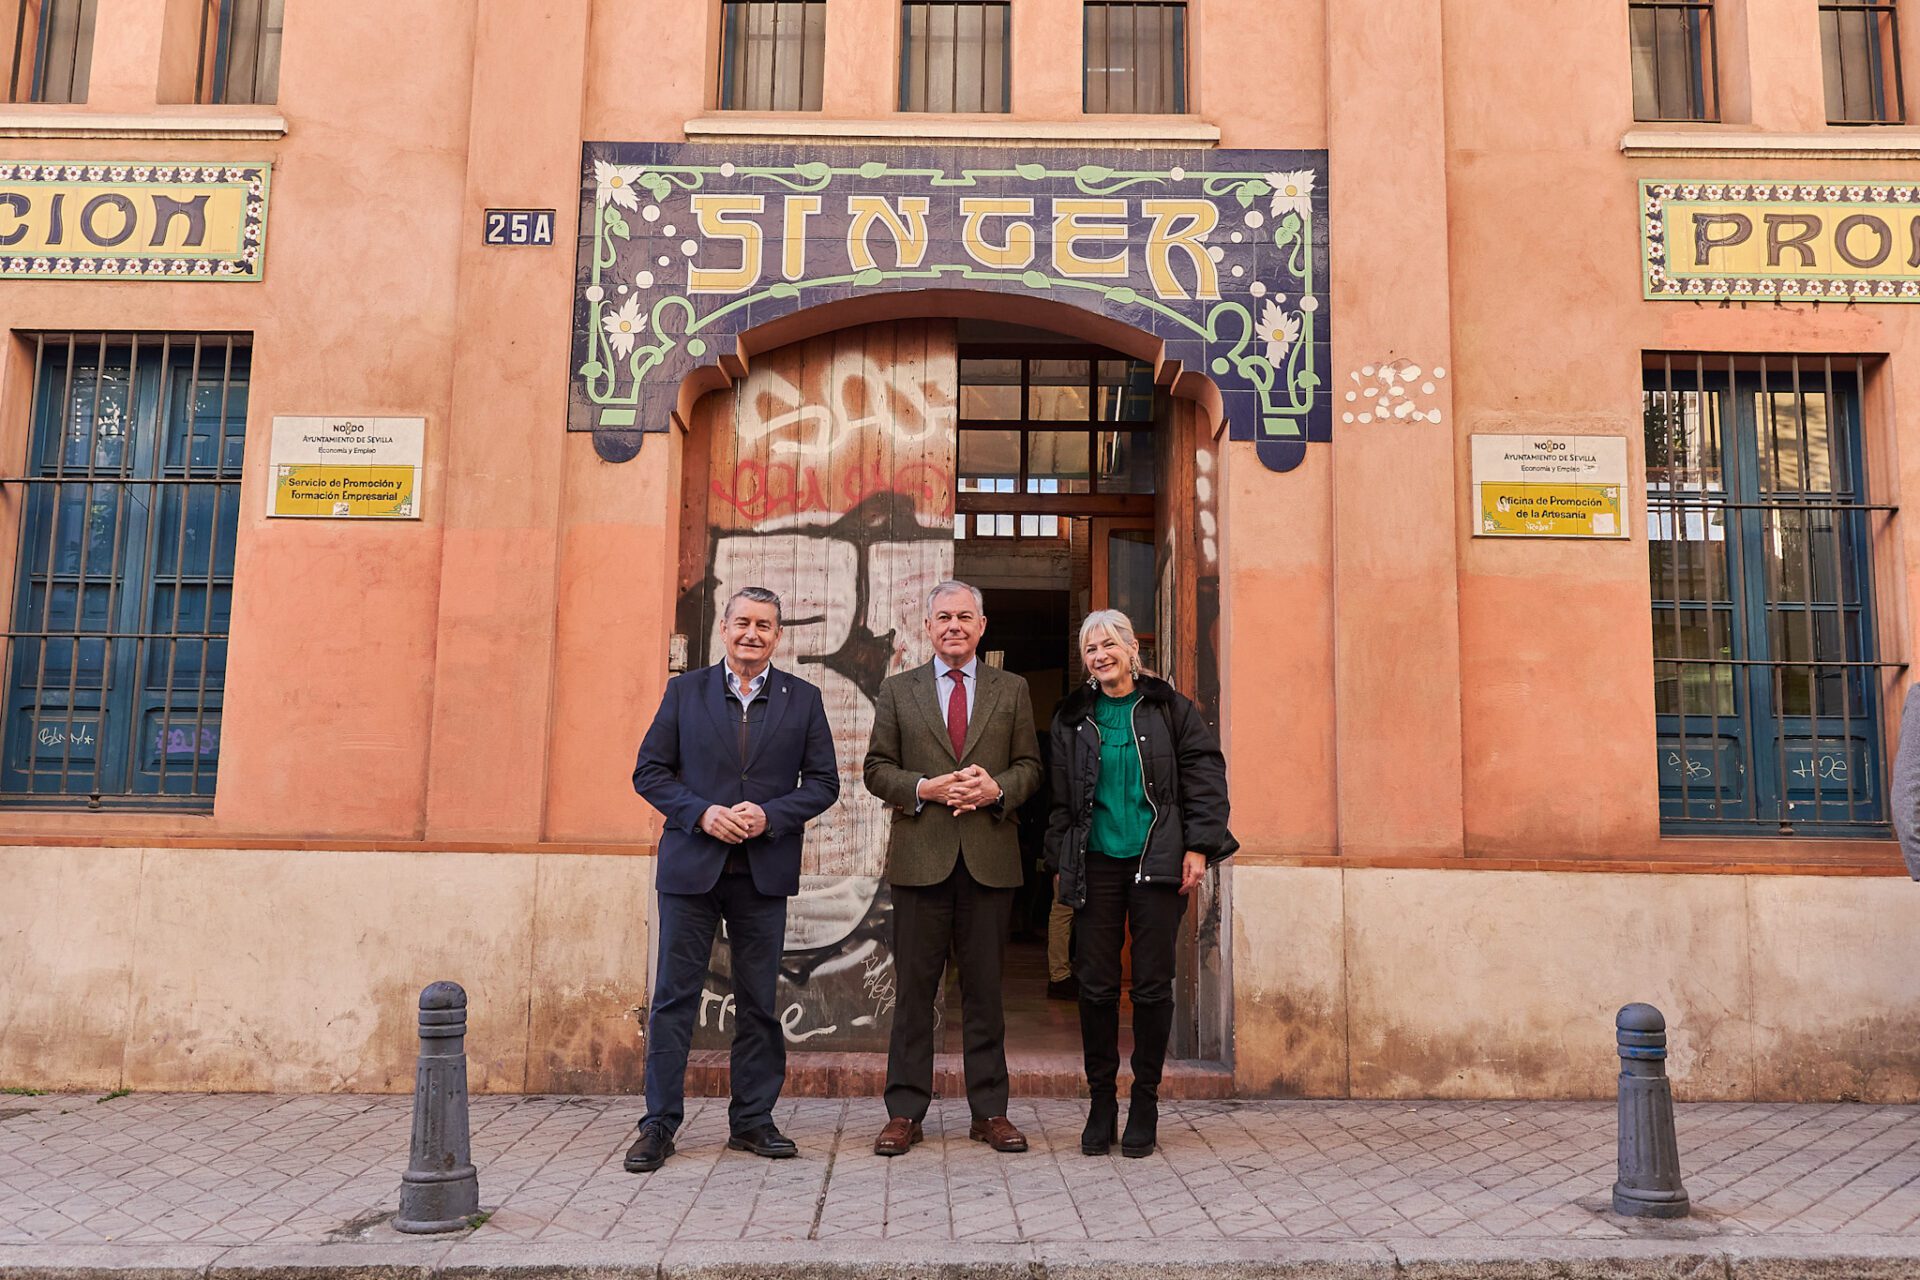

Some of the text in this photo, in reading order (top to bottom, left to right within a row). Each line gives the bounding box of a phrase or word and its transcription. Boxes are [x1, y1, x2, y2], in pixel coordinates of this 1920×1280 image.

[488, 214, 551, 242] 25A
[1692, 213, 1920, 268] PRO
[687, 195, 1222, 300] SINGER
[354, 447, 376, 455] Empleo
[1570, 454, 1596, 462] SEVILLA
[288, 478, 402, 489] Servicio de Promoción y
[291, 490, 398, 502] Formación Empresarial
[1499, 496, 1602, 506] Oficina de Promoción
[1516, 509, 1586, 519] de la Artesanía
